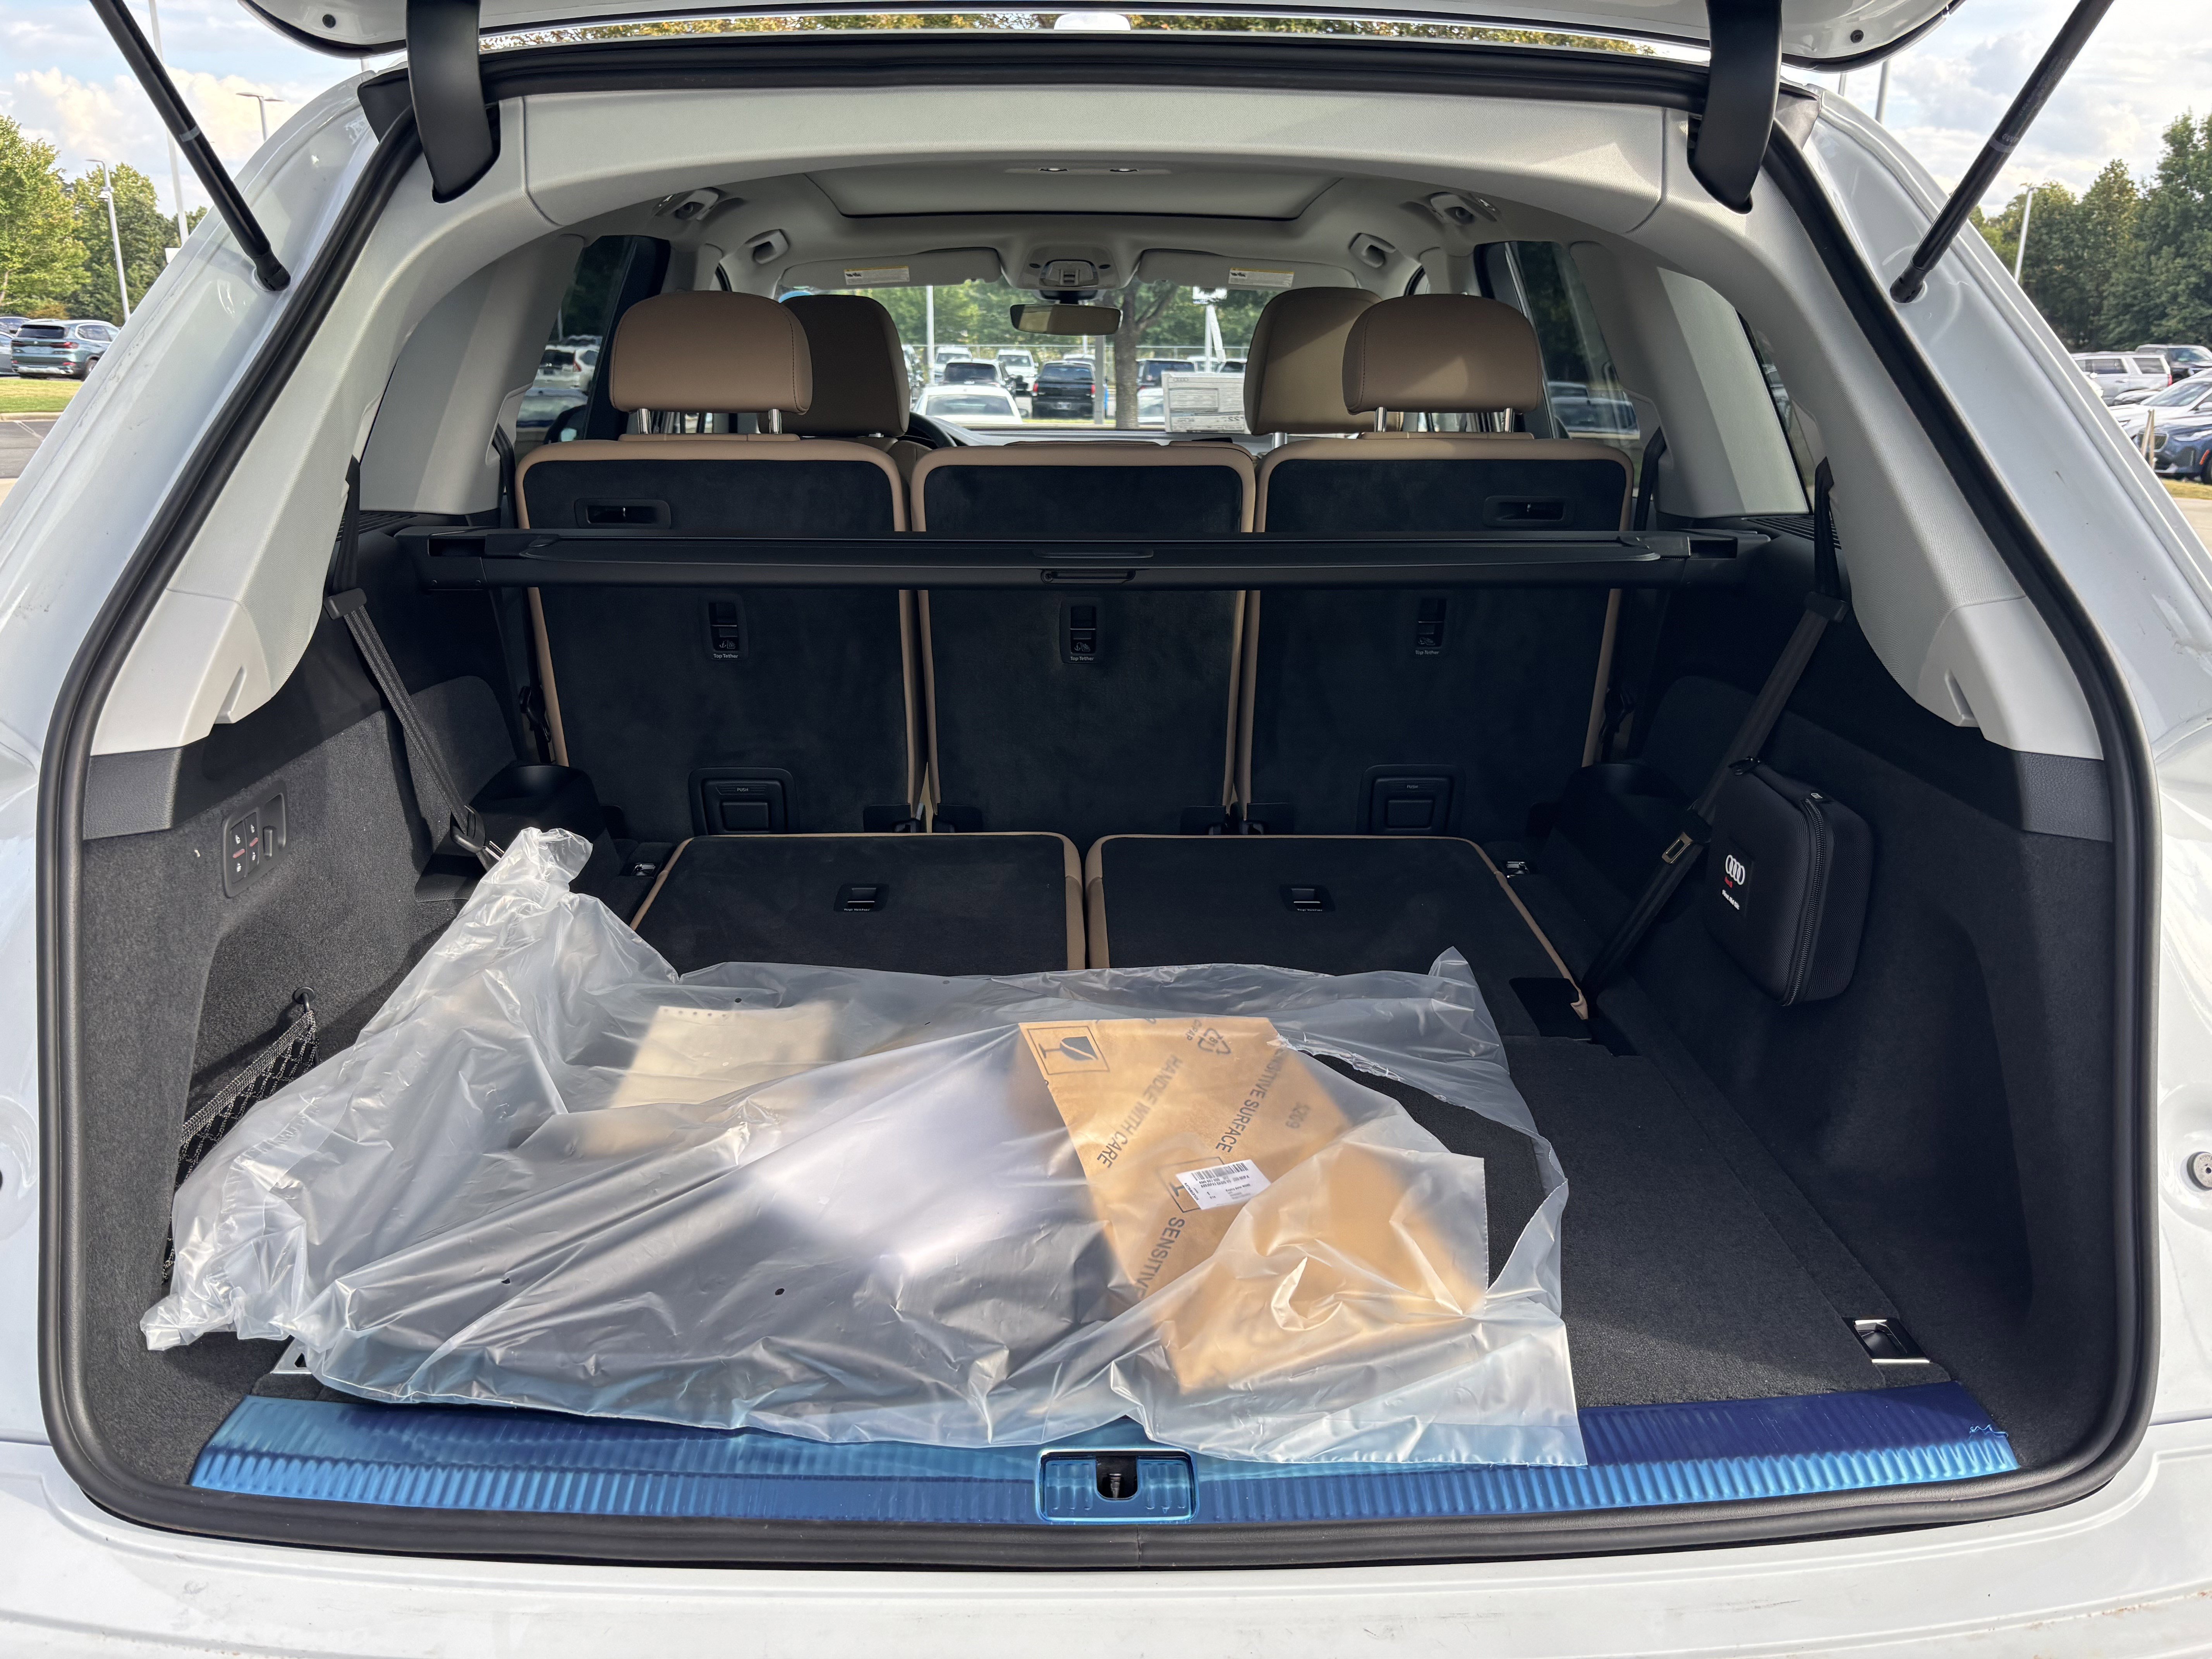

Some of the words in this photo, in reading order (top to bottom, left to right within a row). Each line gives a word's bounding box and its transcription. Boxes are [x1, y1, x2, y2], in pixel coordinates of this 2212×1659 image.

[1143, 1054, 1183, 1105] HANDLE
[1123, 1100, 1151, 1136] WITH
[1215, 1099, 1260, 1153] SURFACE
[1097, 1130, 1128, 1168] CARE
